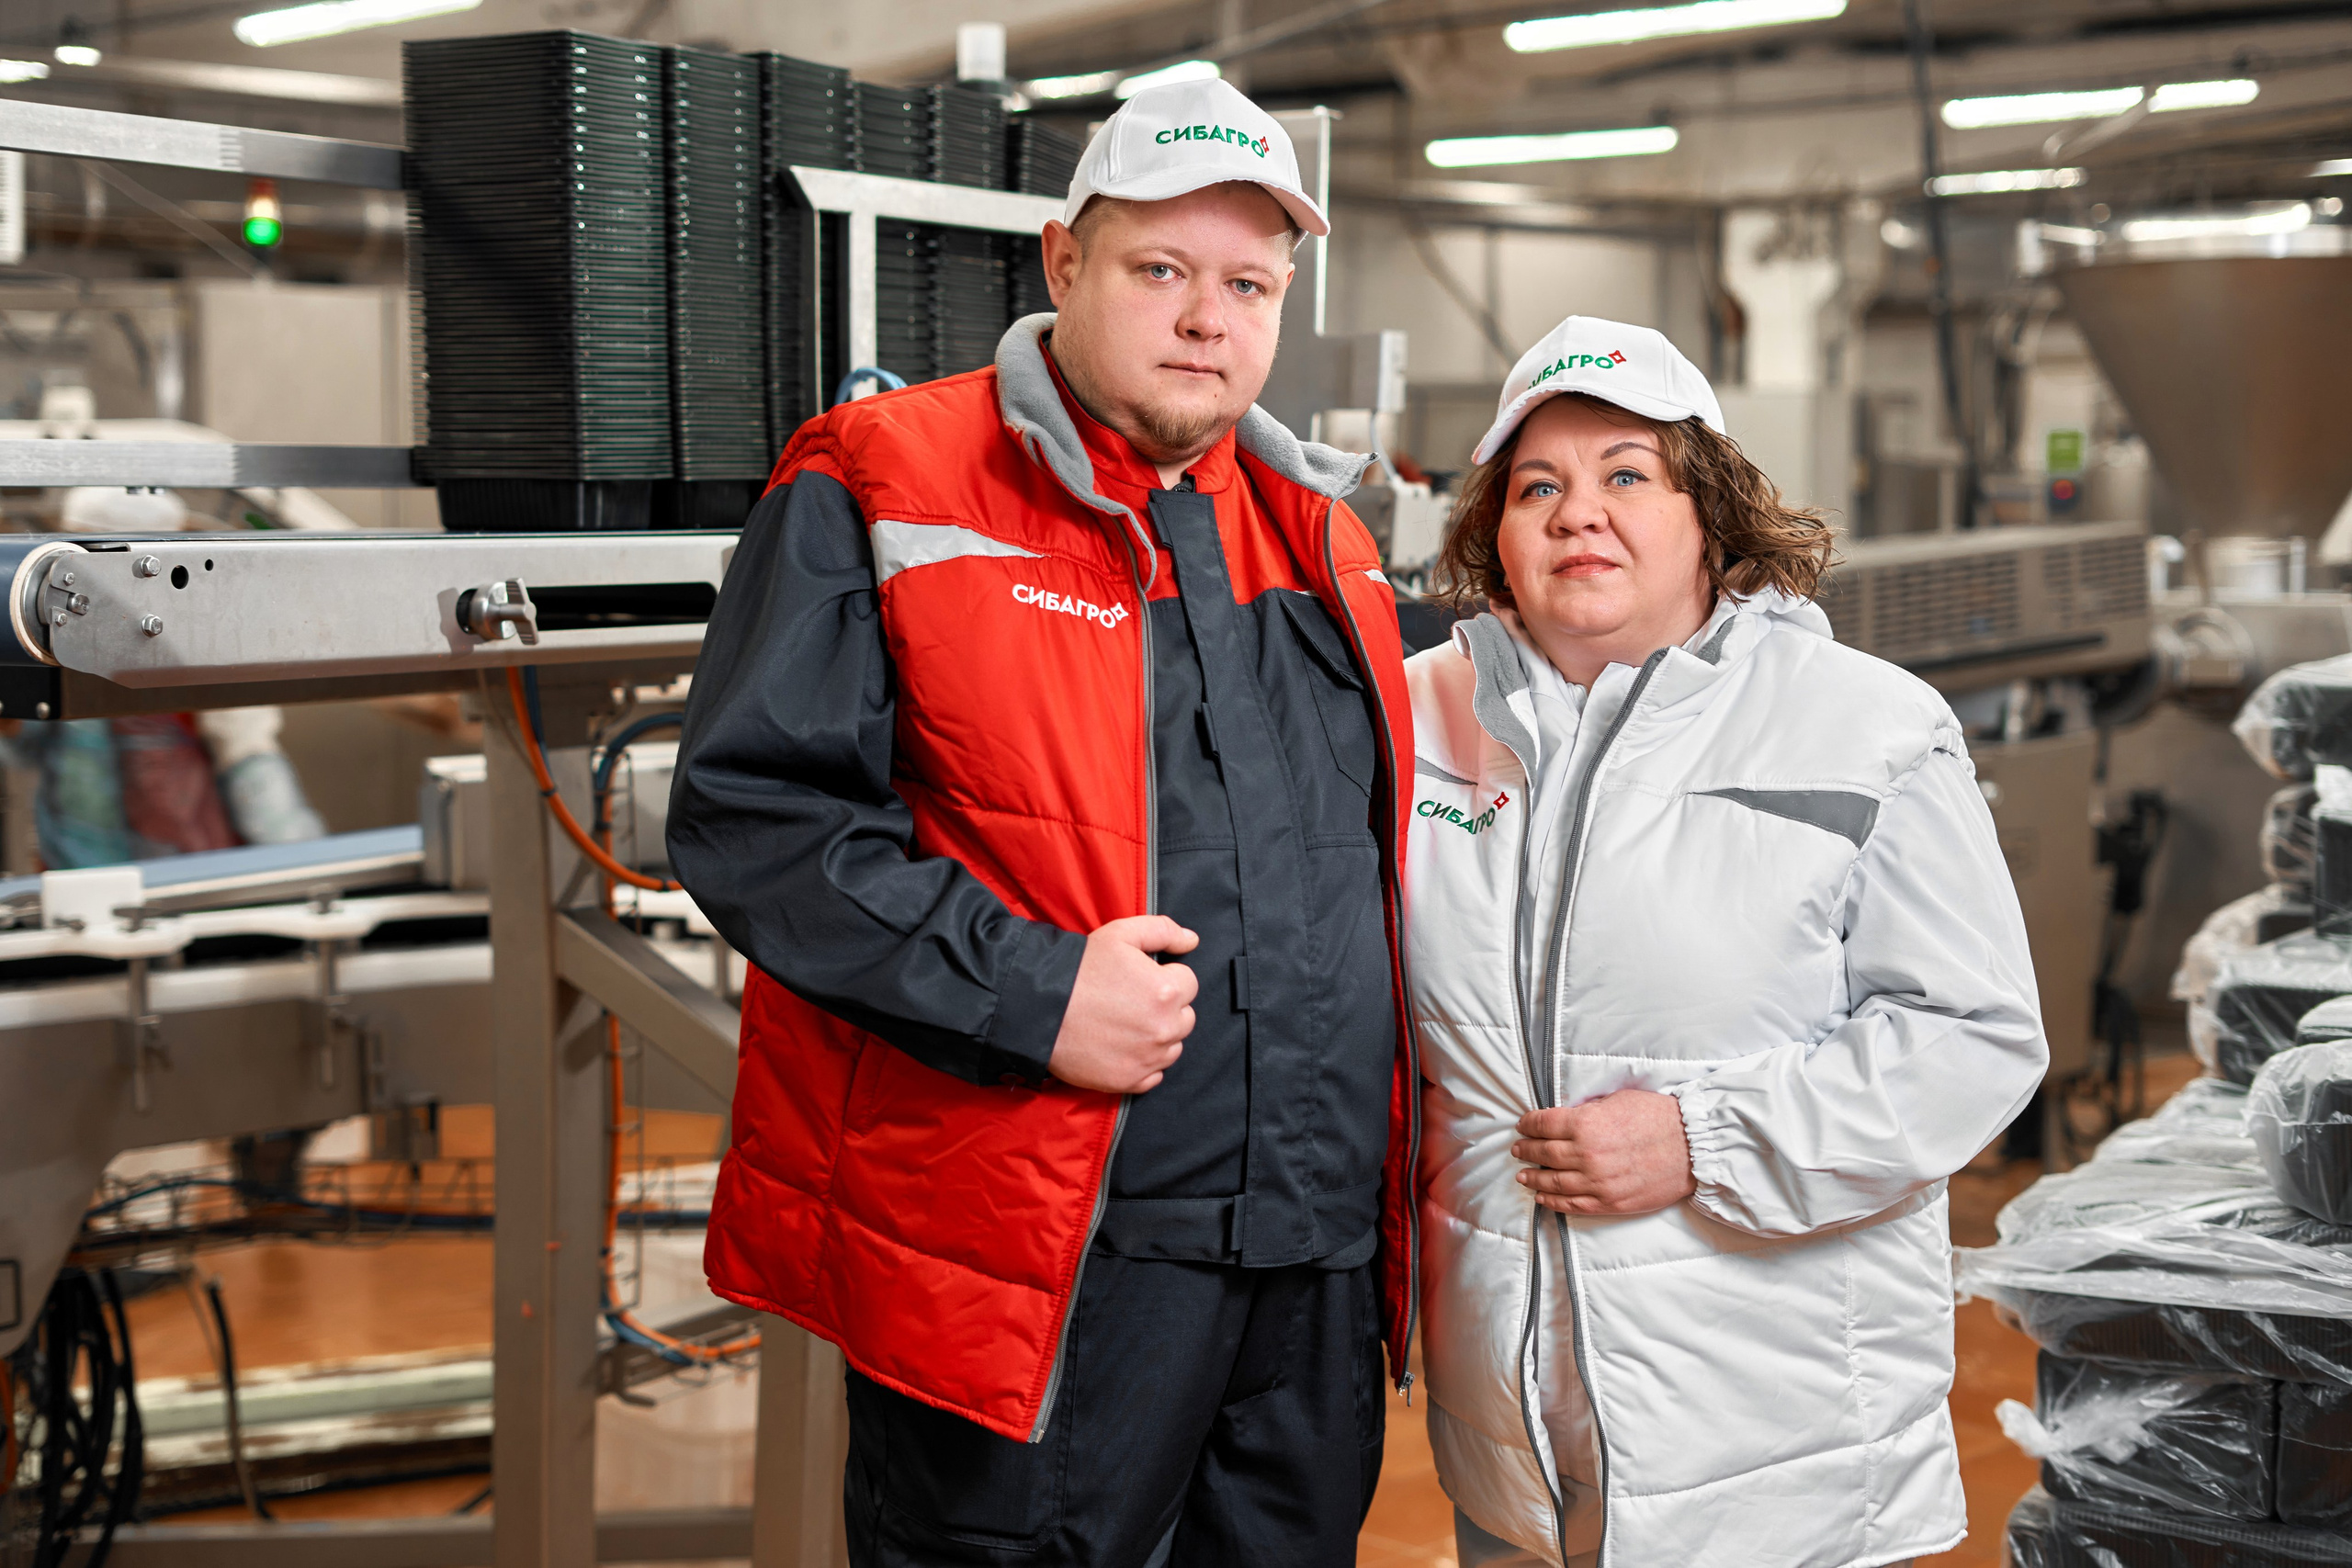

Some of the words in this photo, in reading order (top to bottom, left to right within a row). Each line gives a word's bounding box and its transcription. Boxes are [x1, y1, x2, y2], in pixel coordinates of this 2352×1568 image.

[1155, 124, 1265, 158] СИБАГРО
[1527, 354, 1615, 390] ИБАГРО
[1012, 583, 1116, 628] СИБАГРО
[1417, 800, 1496, 835] СИБАГРО
